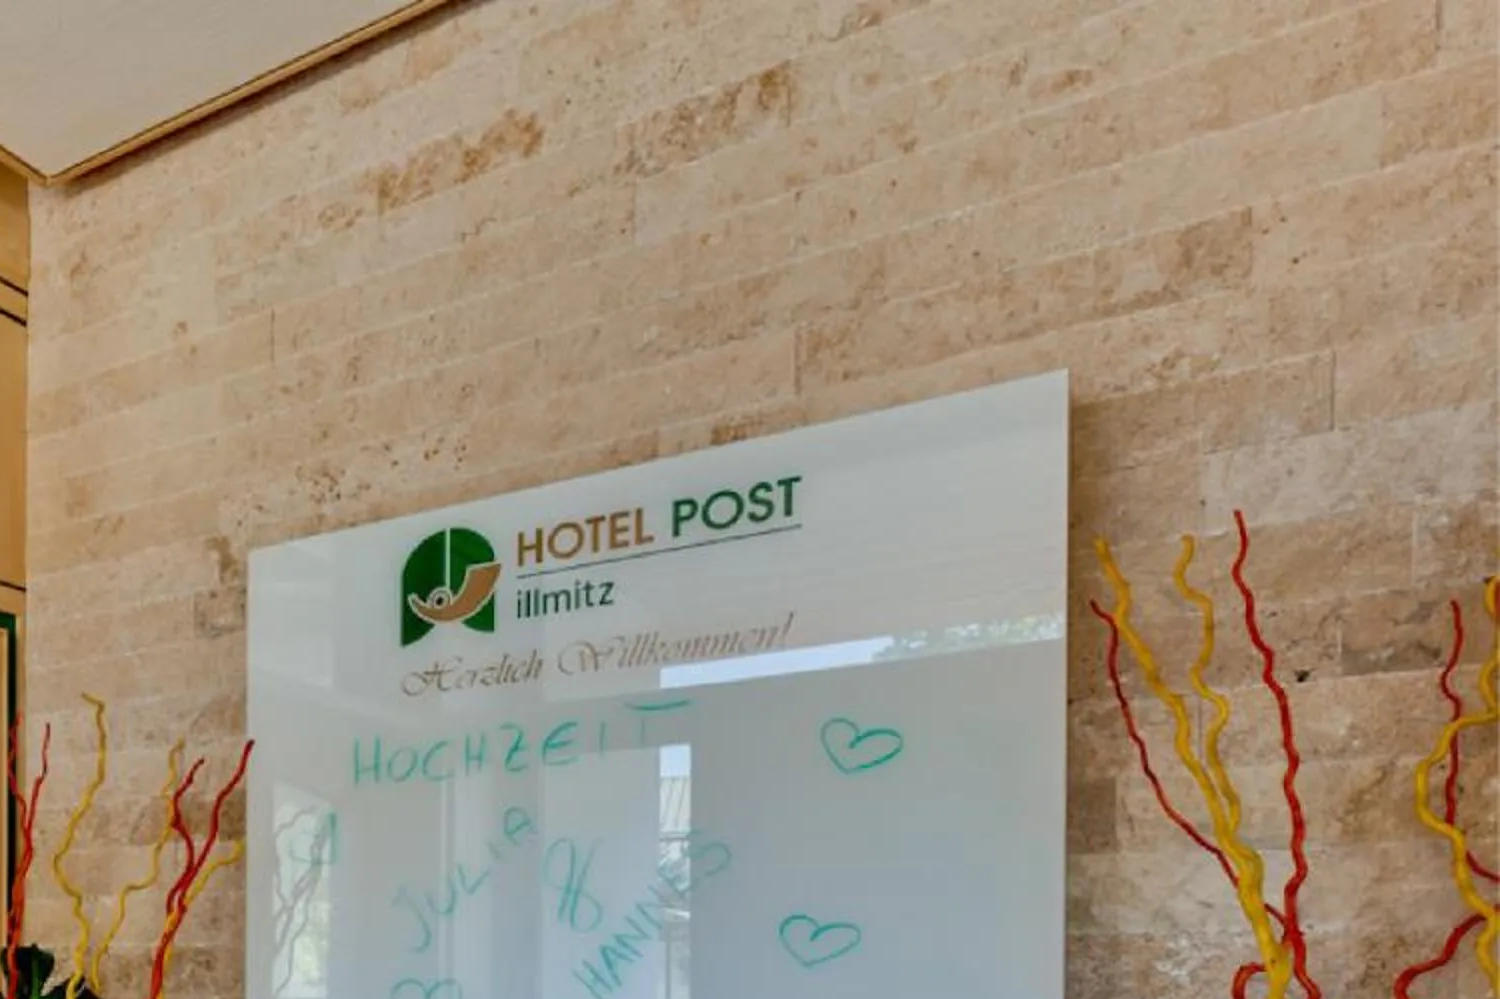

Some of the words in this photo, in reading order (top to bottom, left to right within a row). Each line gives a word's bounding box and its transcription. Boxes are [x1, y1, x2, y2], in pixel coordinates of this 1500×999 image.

[516, 507, 654, 567] HOTEL
[671, 476, 803, 538] POST
[516, 580, 615, 619] illmitz
[402, 649, 543, 697] Herzlich
[556, 611, 795, 675] Willkommen!
[353, 698, 691, 784] HOCHZEIT
[390, 805, 538, 954] JULIA
